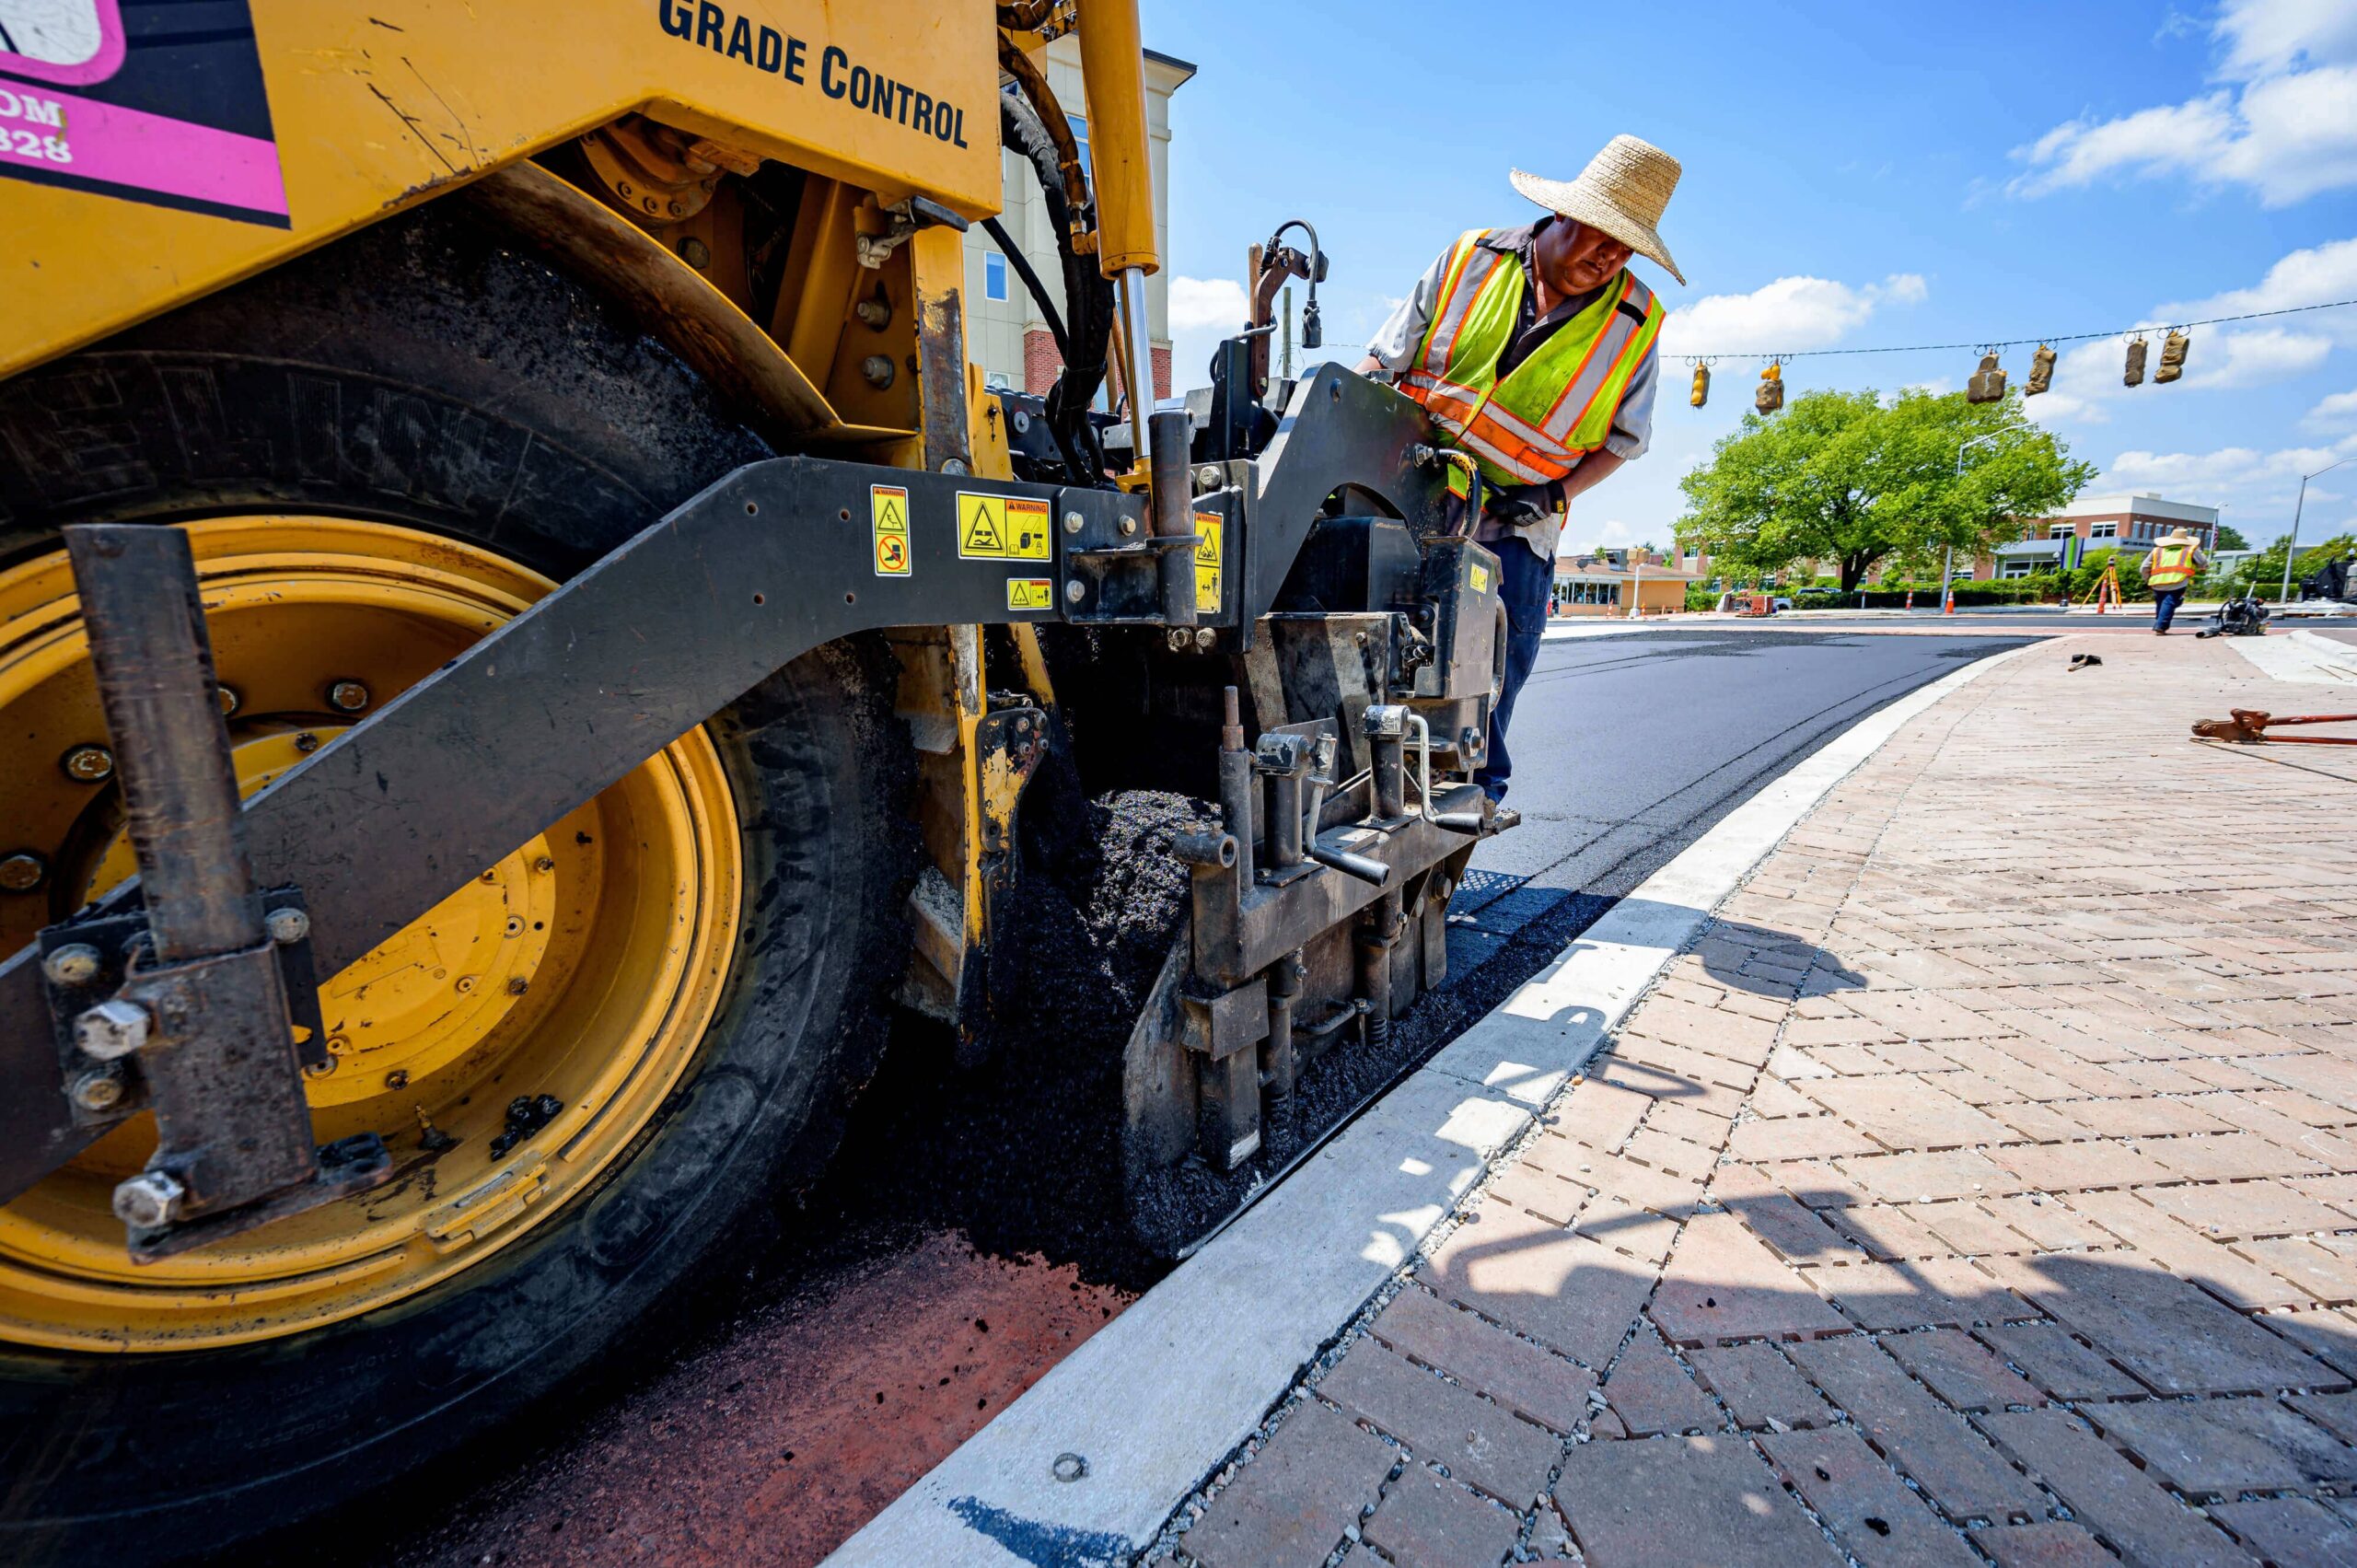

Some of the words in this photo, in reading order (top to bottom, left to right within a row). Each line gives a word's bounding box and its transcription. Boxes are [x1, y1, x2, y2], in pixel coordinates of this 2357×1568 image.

[658, 0, 807, 86] GRADE
[820, 45, 969, 149] CONTROL
[1016, 503, 1047, 513] WARNING
